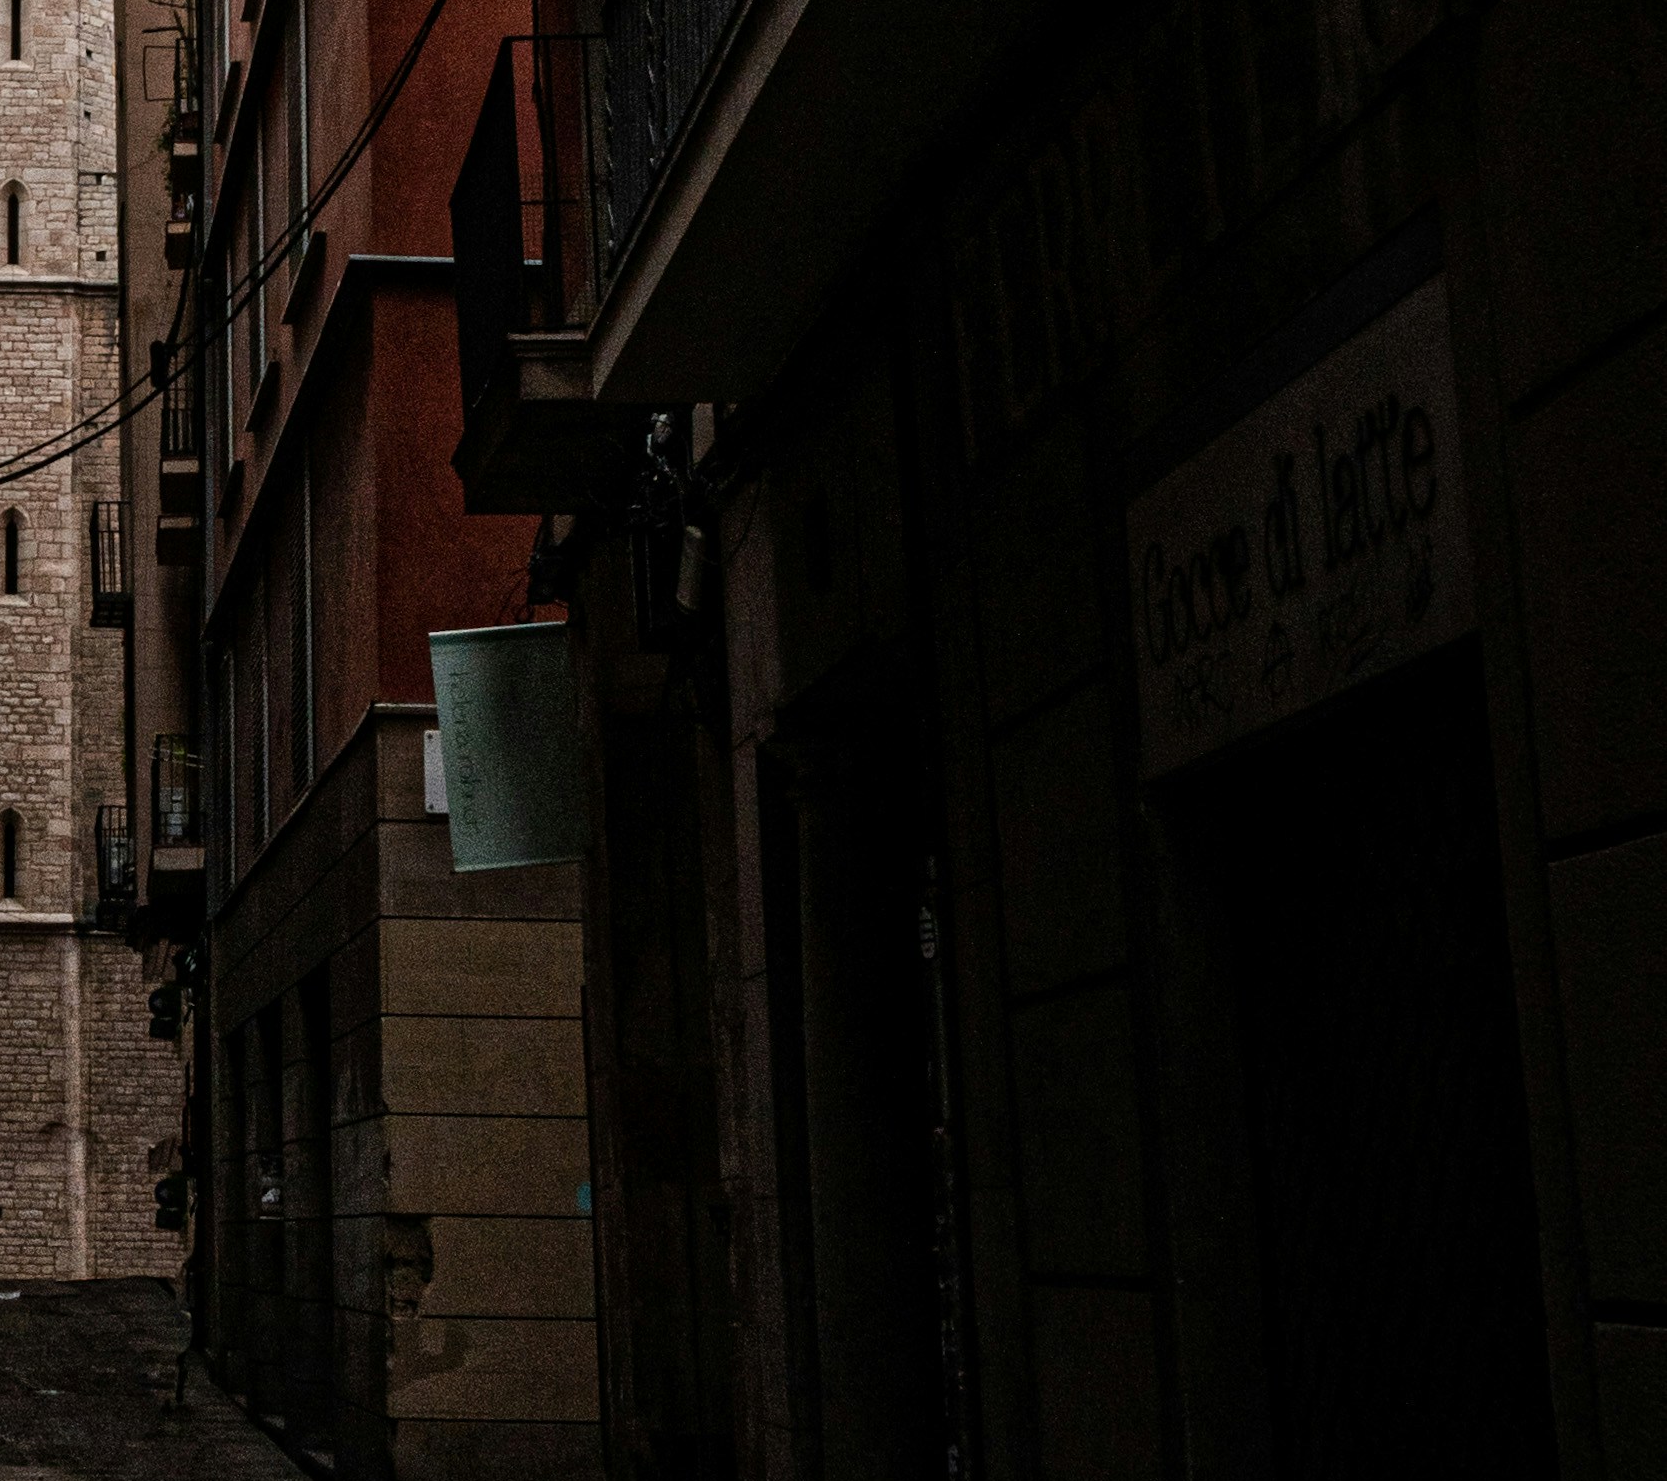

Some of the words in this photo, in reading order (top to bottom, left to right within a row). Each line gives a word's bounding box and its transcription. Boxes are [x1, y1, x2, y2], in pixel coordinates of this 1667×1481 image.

[1142, 525, 1252, 666] Gocce
[1264, 453, 1305, 597] di
[1315, 393, 1438, 572] latte
